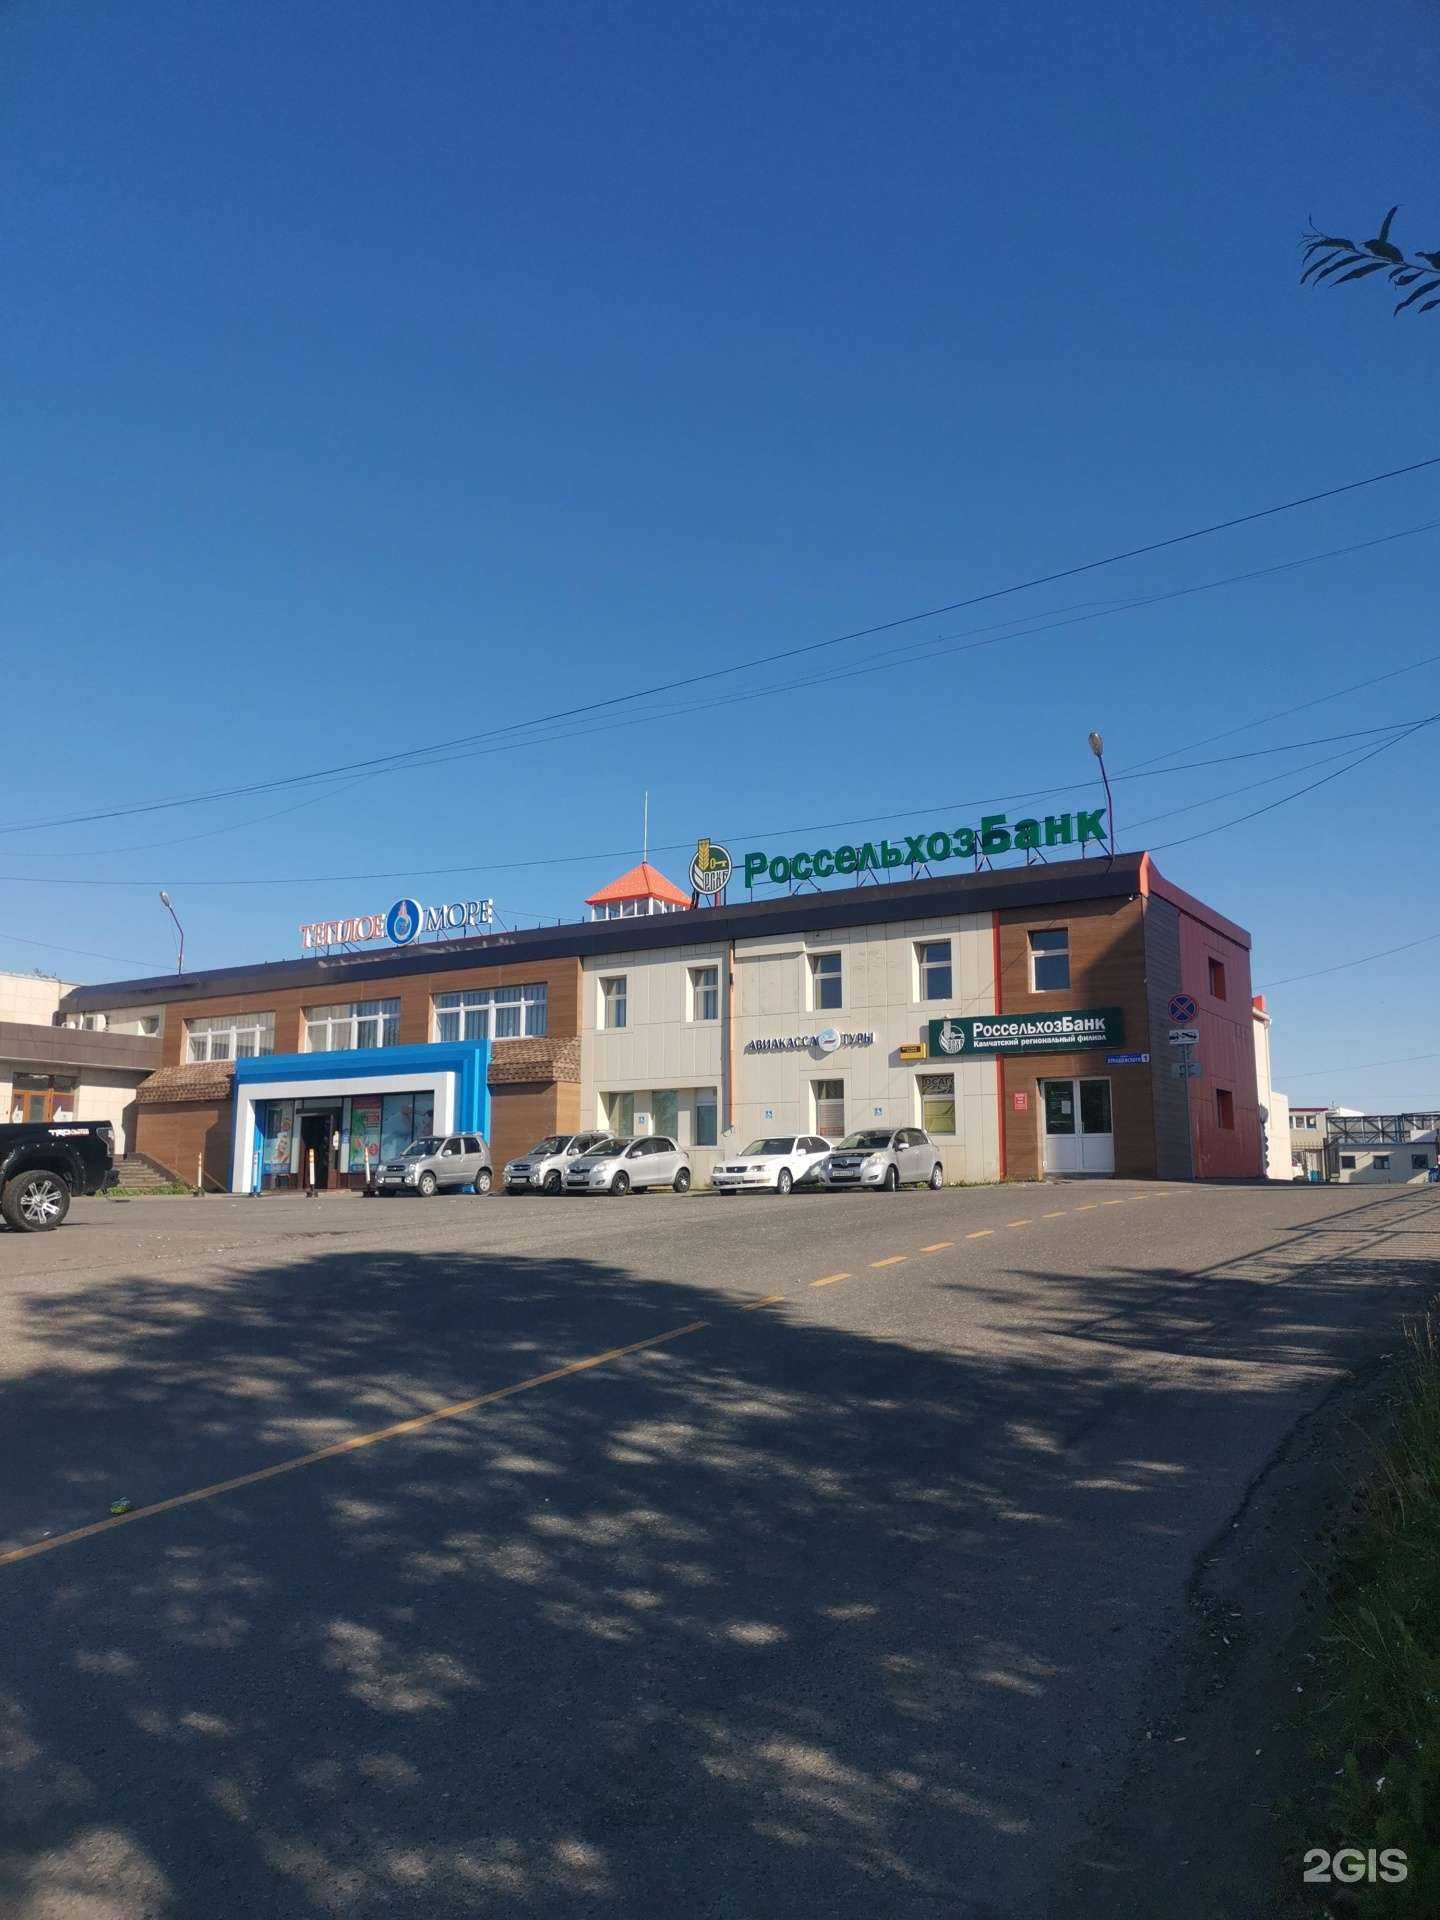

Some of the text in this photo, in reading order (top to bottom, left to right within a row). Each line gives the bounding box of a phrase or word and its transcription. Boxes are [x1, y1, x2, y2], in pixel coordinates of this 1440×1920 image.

[744, 808, 1106, 888] РоссельхозБанк
[300, 899, 493, 948] ТЕПЛОЕ МОРЕ
[973, 1016, 1106, 1038] РоссельхозБанк
[748, 1031, 874, 1051] АВИАКАССА ТУРЫ
[973, 1038, 1019, 1048] Камчатский
[1020, 1035, 1076, 1047] региональный
[1077, 1034, 1107, 1044] филиал
